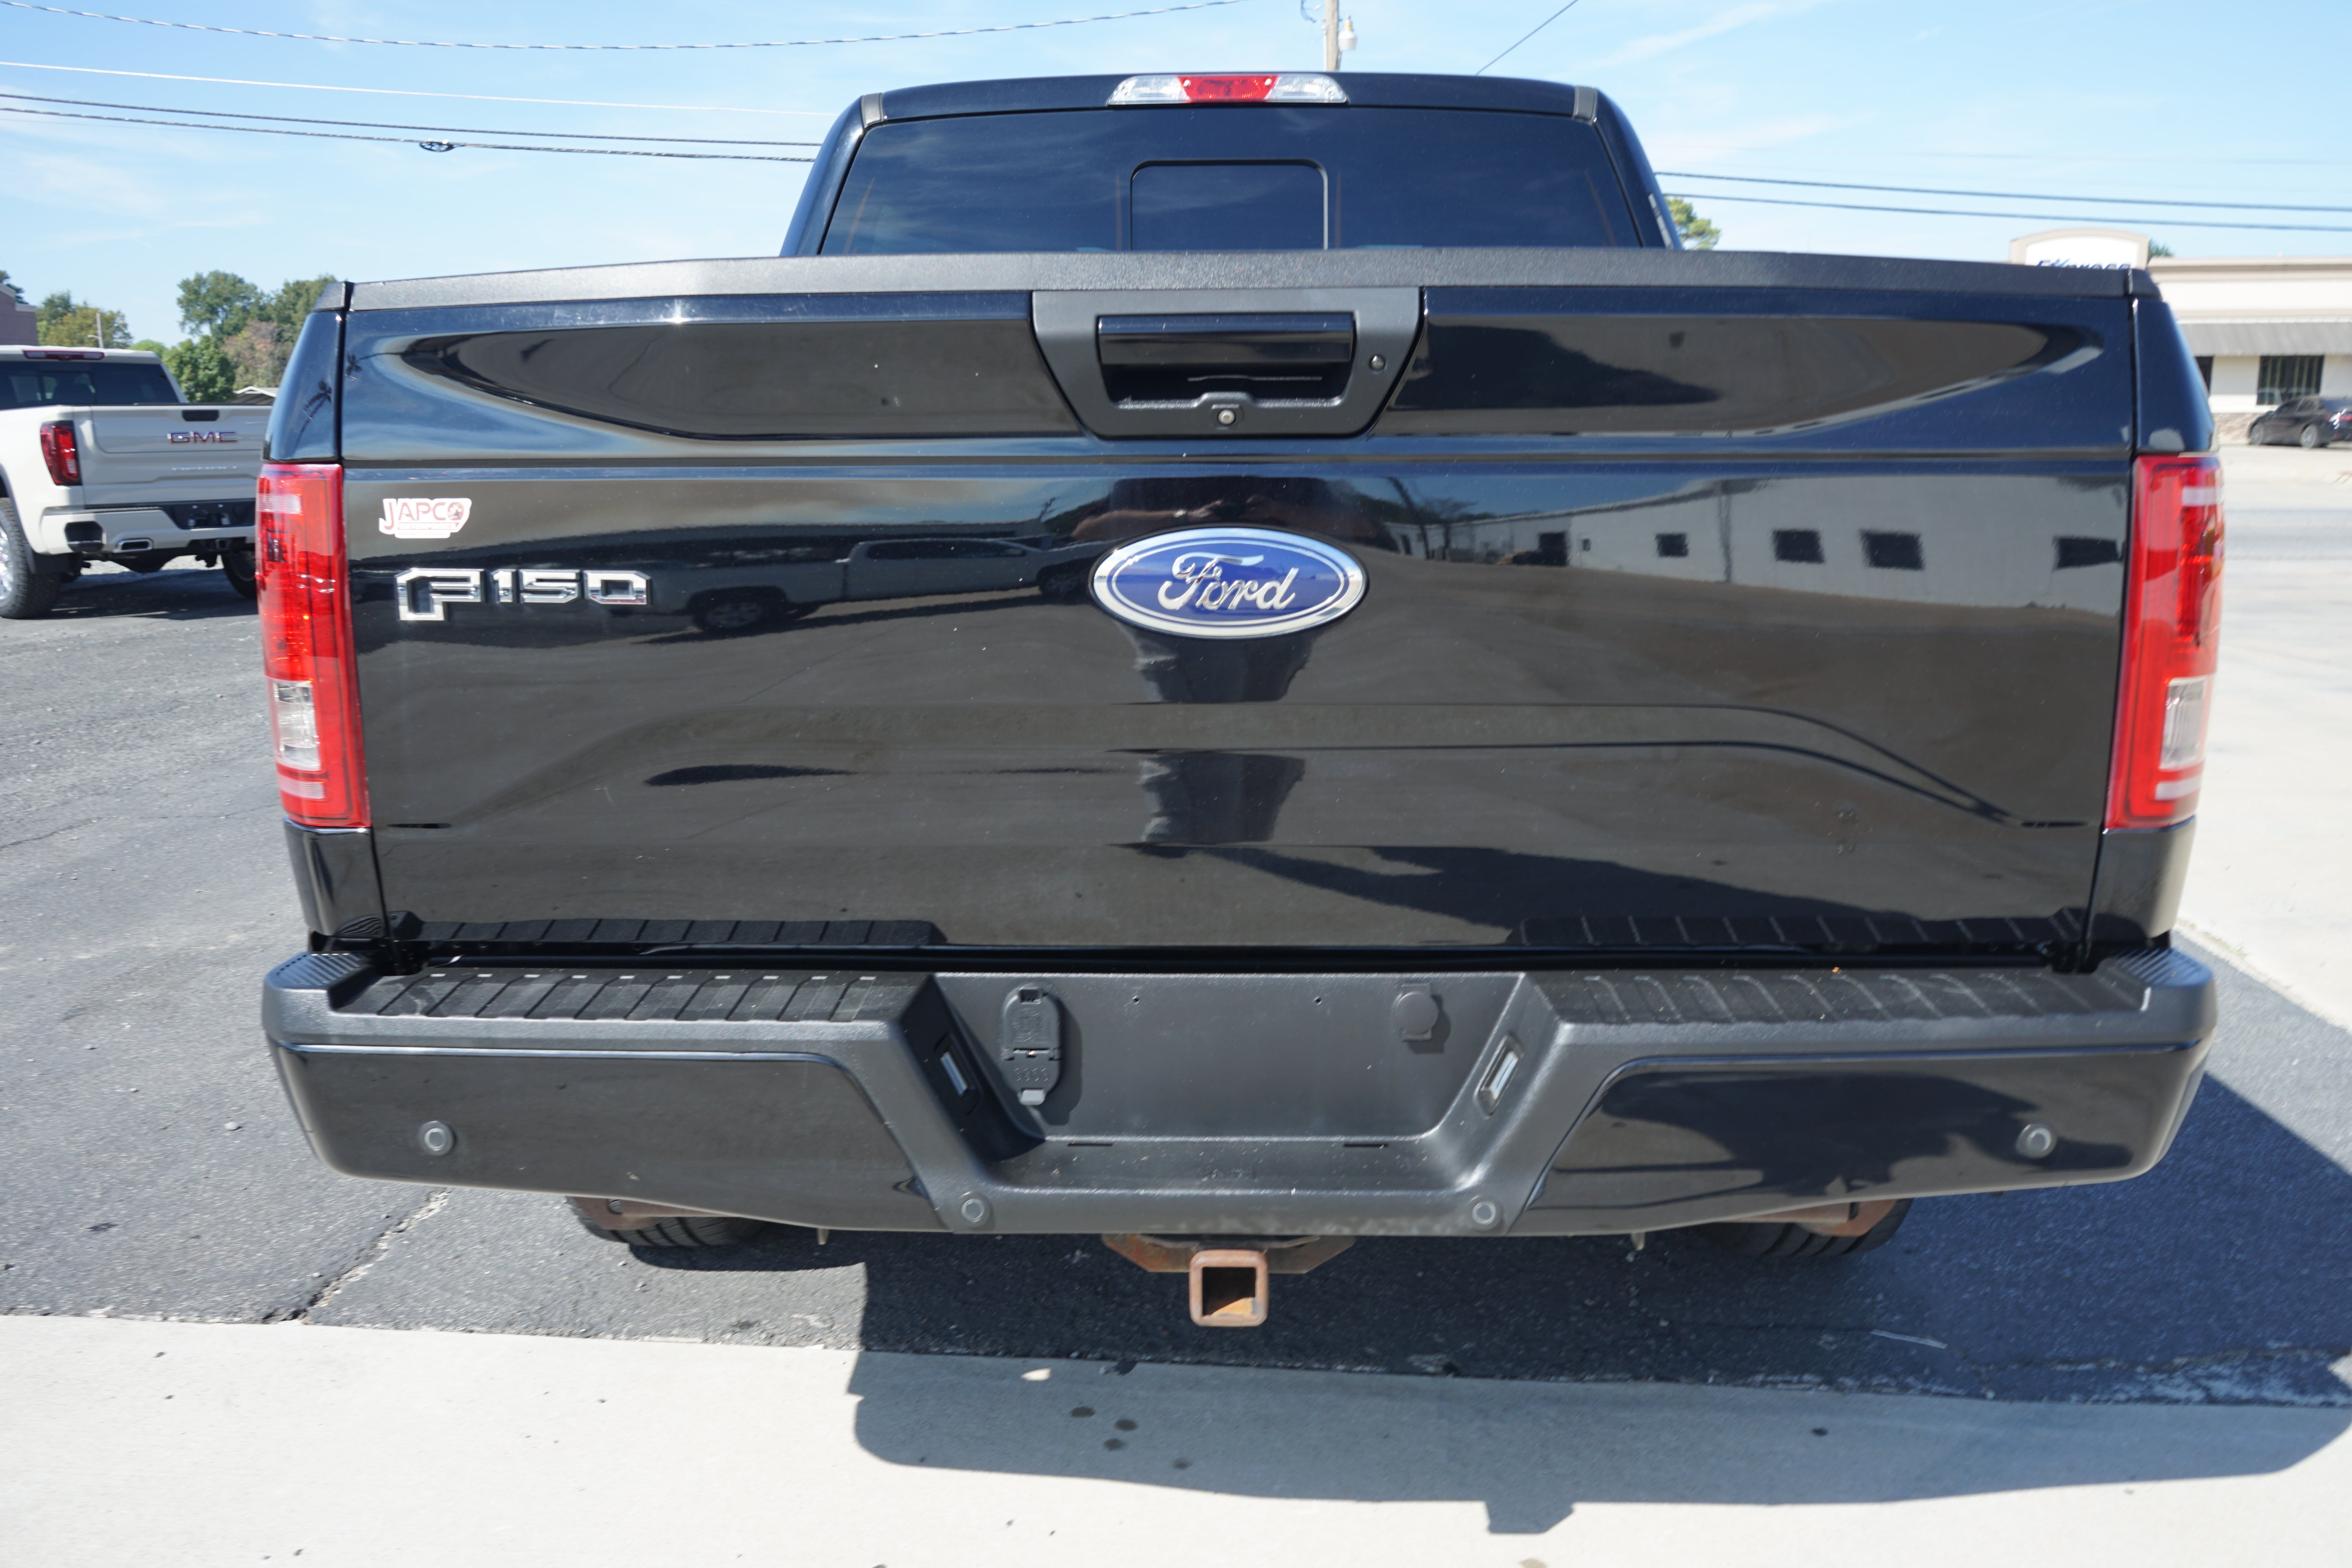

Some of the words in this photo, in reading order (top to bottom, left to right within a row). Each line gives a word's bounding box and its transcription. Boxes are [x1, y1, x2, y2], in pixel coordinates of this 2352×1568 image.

[168, 431, 238, 443] GMC
[384, 502, 464, 530] JAPCO
[1157, 551, 1299, 610] Ford
